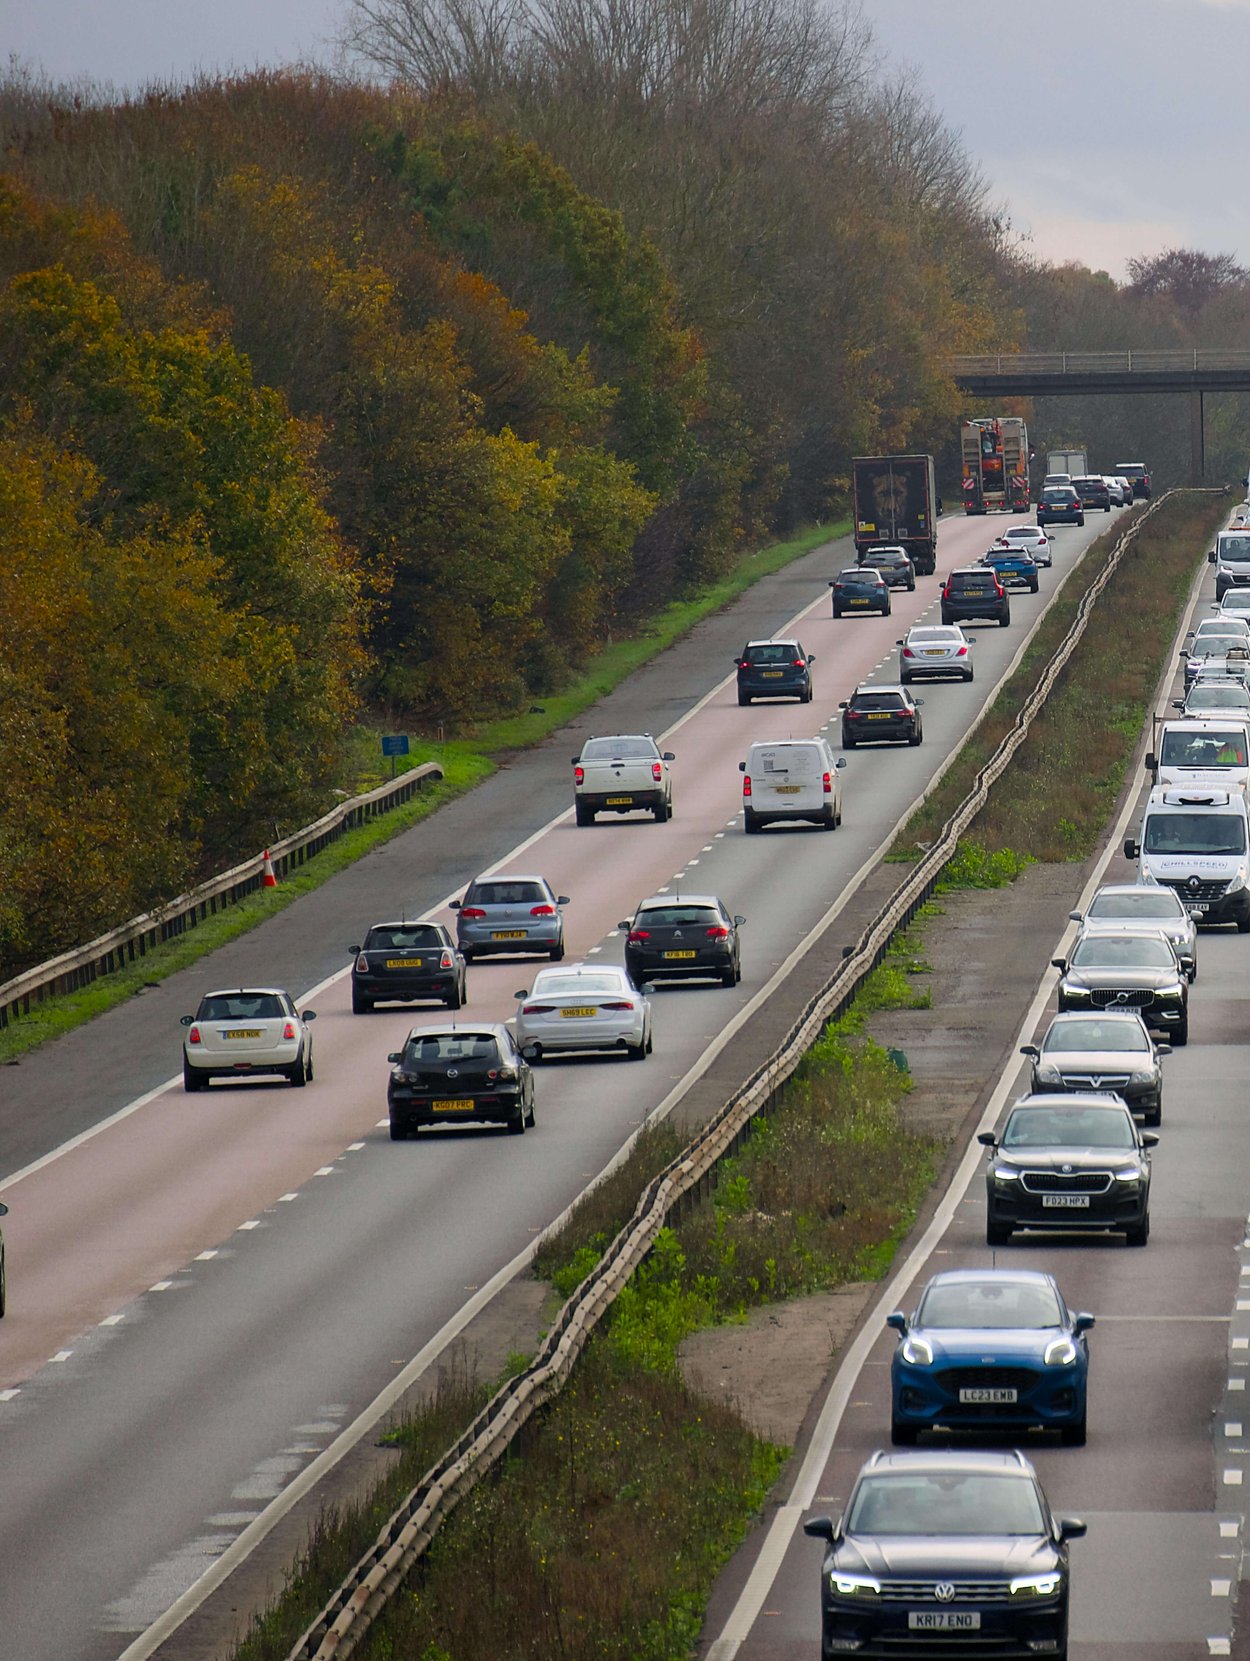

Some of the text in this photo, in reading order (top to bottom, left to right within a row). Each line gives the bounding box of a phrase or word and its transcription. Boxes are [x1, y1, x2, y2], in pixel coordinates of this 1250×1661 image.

[1046, 1196, 1086, 1206] FD23 HPX
[964, 1390, 991, 1401] LC23
[916, 1614, 945, 1626] KR17
